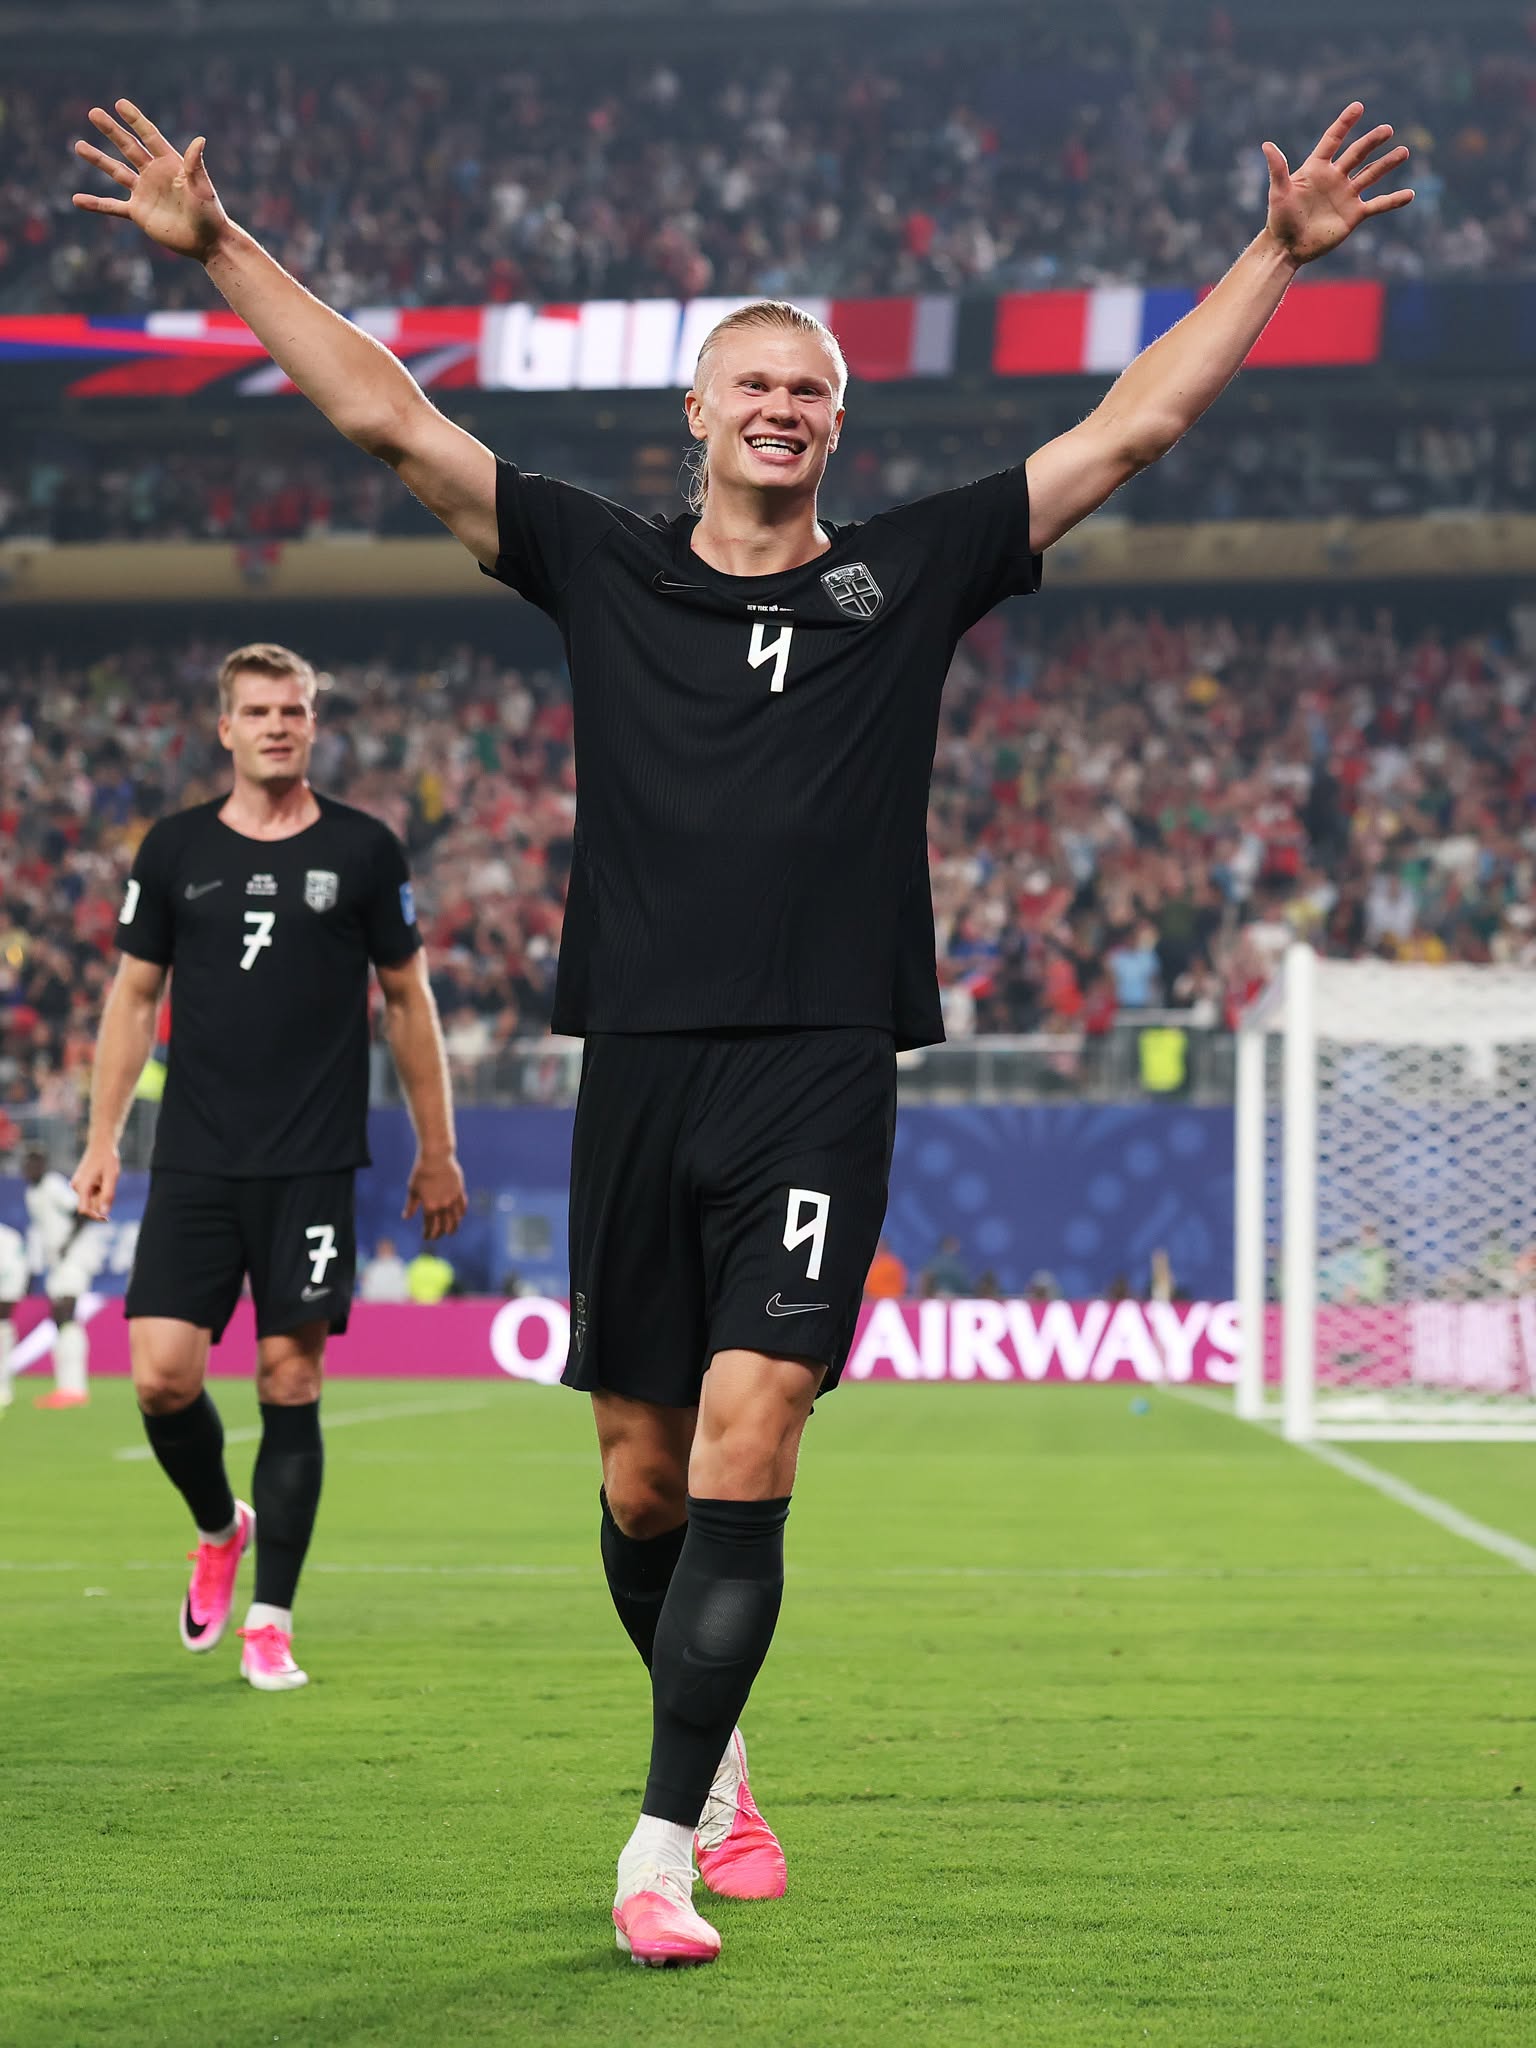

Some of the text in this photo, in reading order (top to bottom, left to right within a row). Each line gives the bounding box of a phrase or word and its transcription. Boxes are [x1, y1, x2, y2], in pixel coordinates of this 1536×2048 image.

[240, 911, 276, 971] 7
[305, 1225, 338, 1283] 7
[783, 1188, 831, 1281] 9
[851, 1298, 1240, 1382] AIRWAYS
